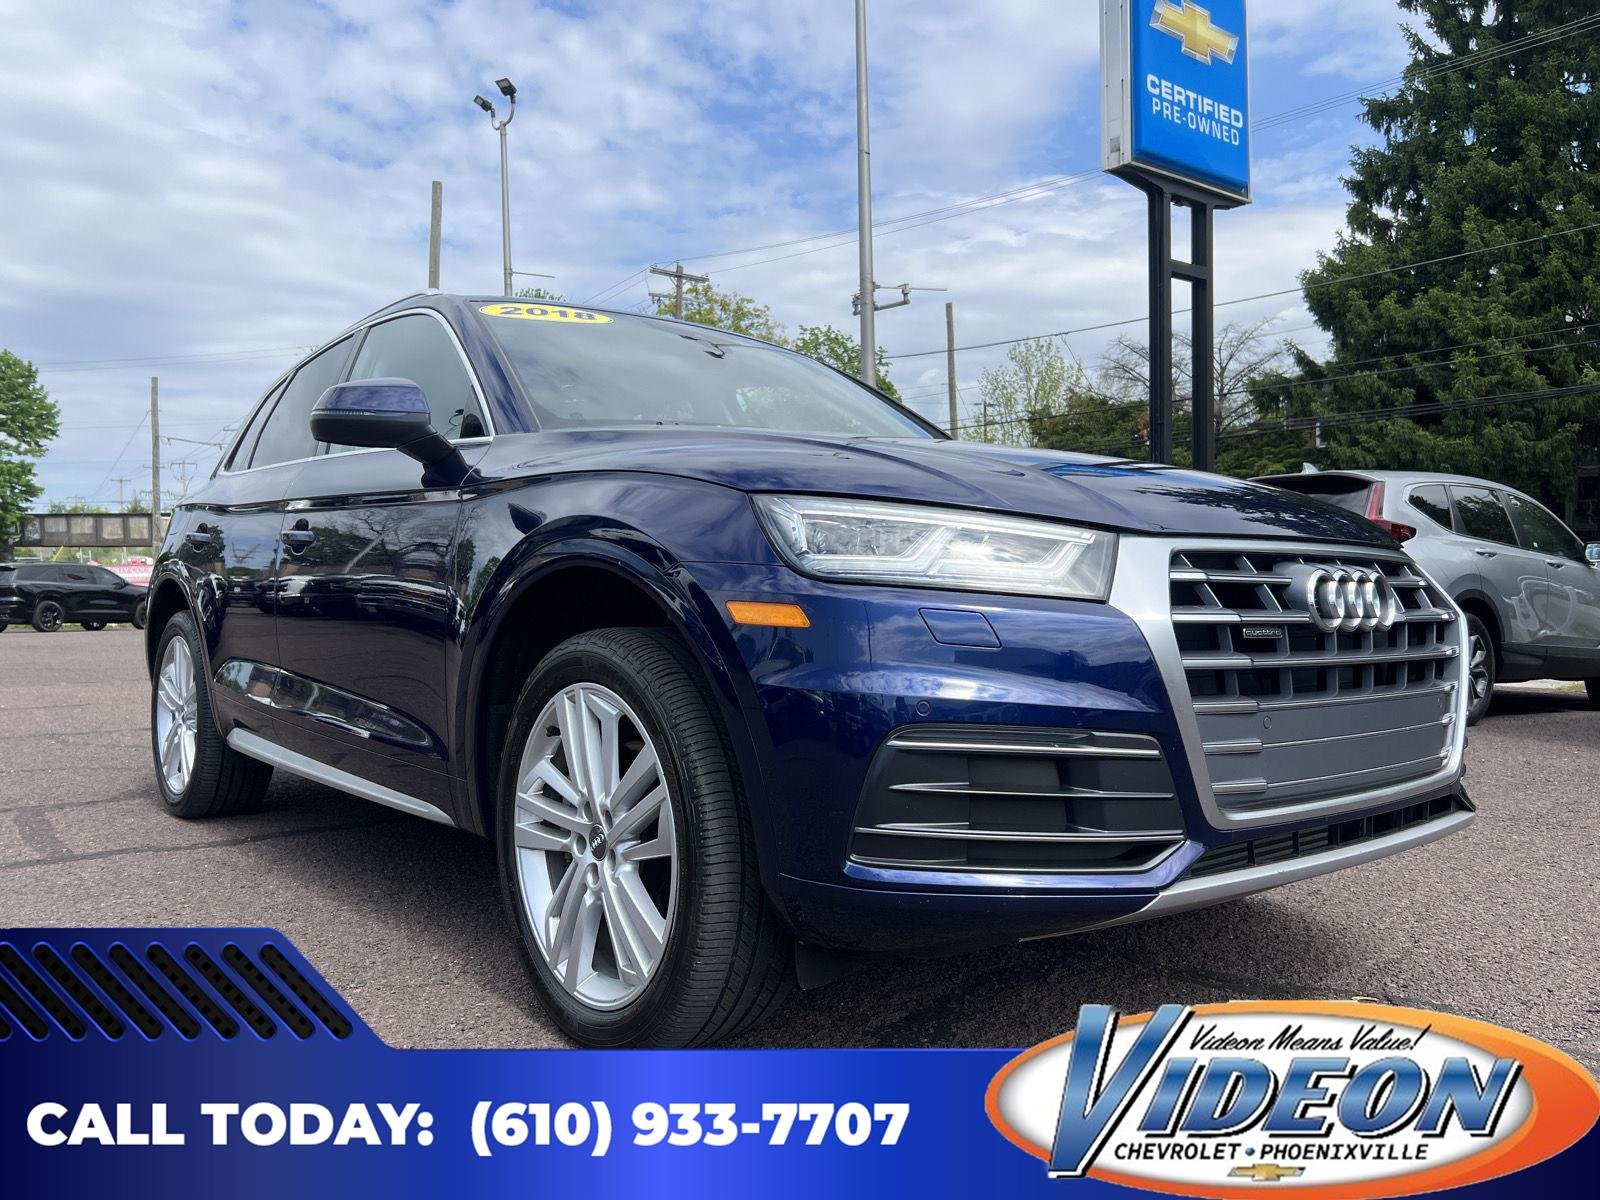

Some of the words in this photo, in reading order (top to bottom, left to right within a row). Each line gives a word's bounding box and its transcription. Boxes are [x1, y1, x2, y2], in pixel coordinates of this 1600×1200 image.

[1146, 73, 1243, 128] CERTIFIED
[1152, 97, 1240, 146] PRE-OWNED
[500, 306, 597, 320] 2018
